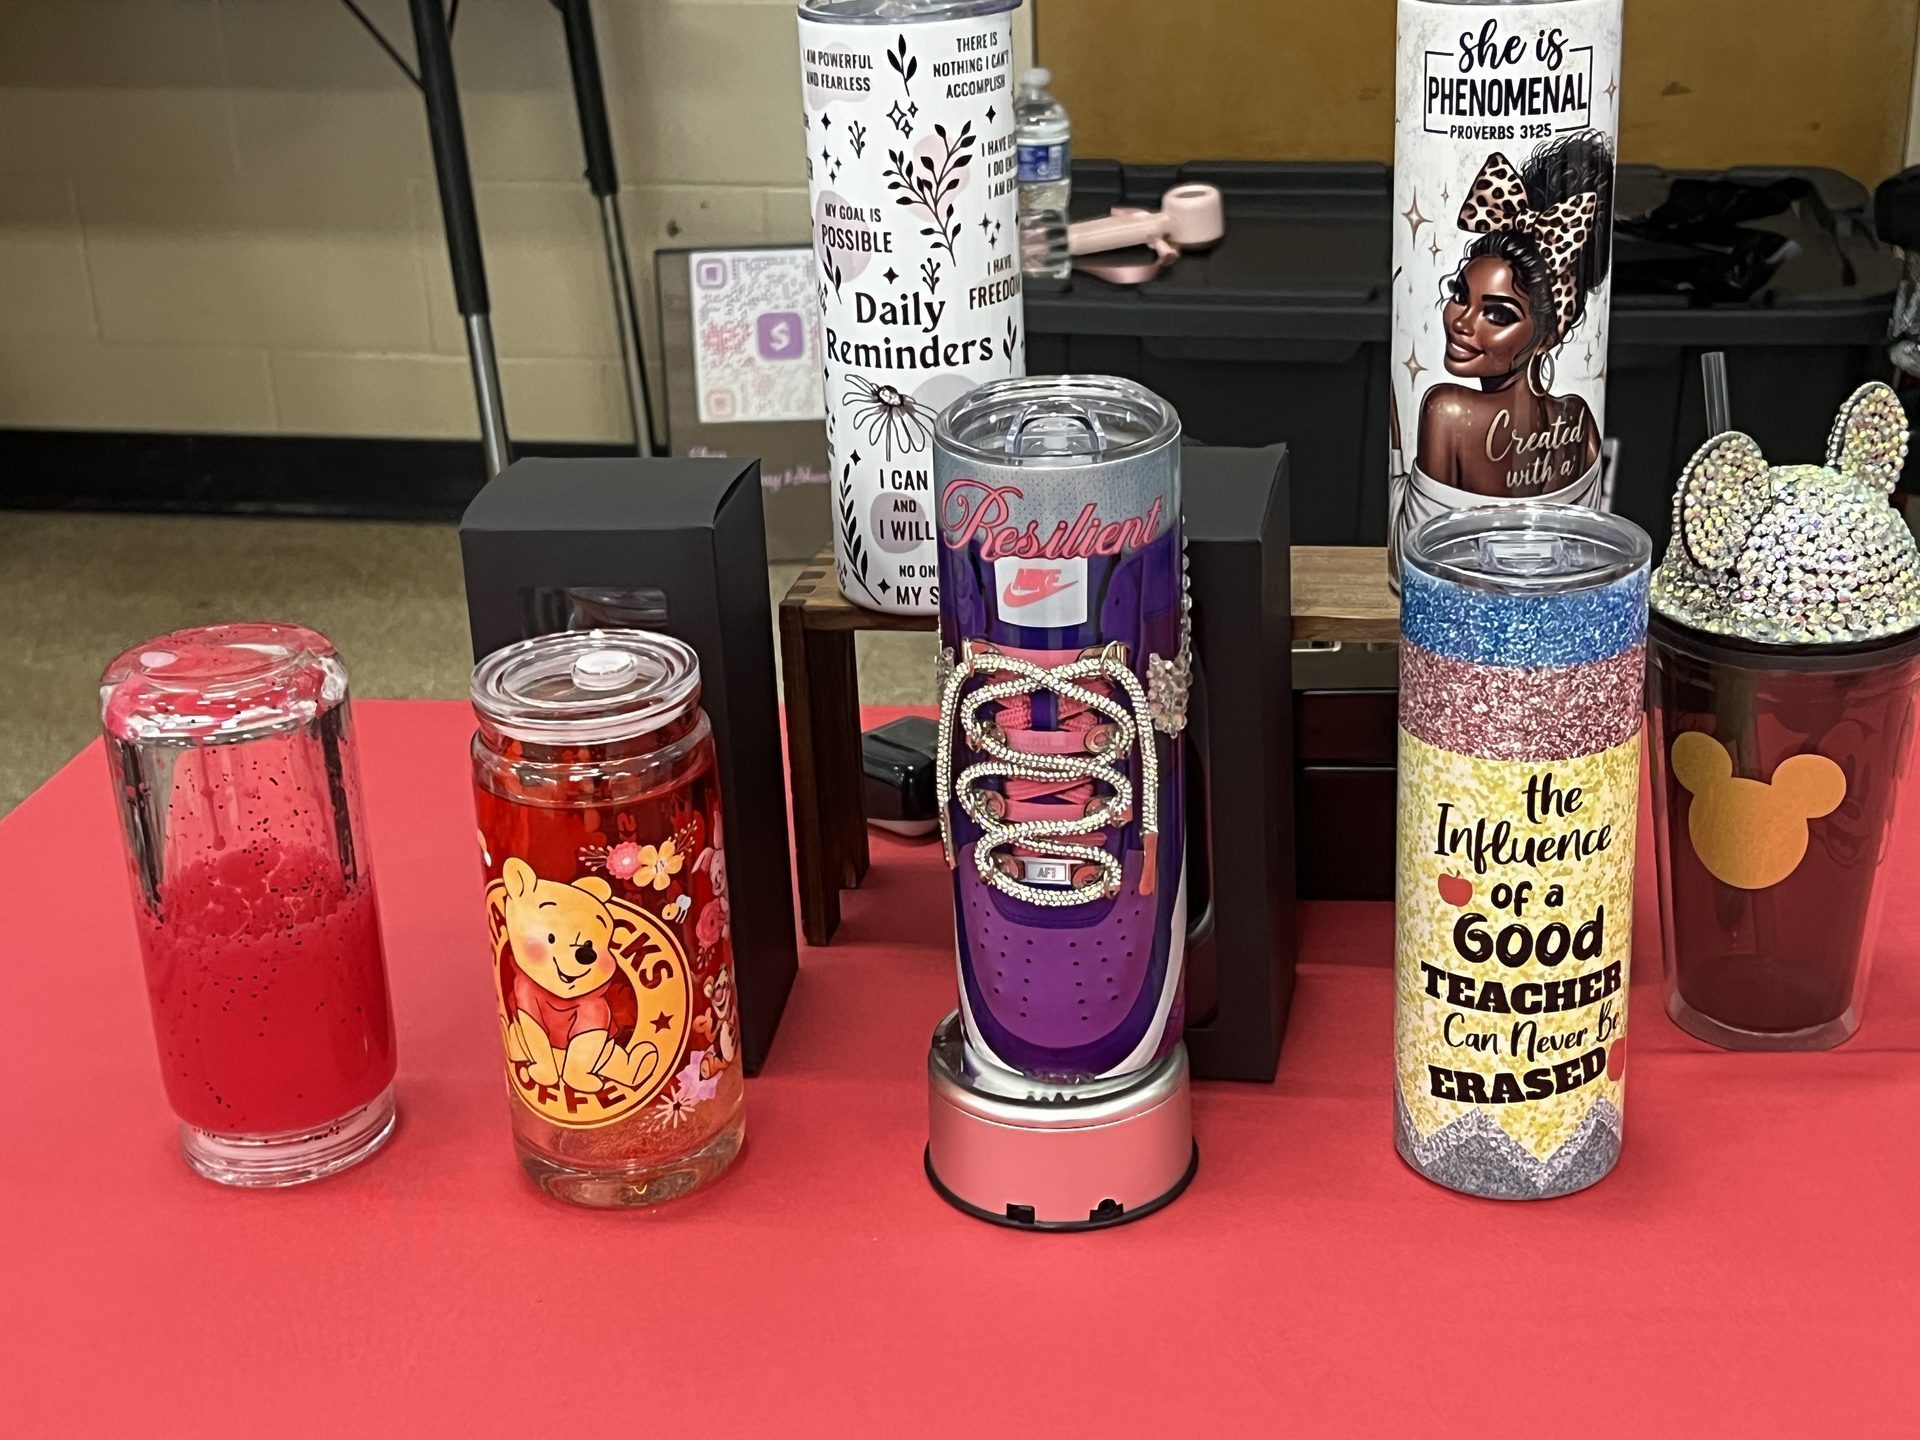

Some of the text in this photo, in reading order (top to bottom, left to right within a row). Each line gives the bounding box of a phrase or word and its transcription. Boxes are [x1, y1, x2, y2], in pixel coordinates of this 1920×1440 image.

[956, 31, 998, 53] THERE IS
[1458, 18, 1569, 73] she is
[818, 51, 873, 69] POWERFUL
[933, 57, 983, 77] NOTHING
[986, 55, 989, 70] I
[821, 73, 871, 92] FEARLESS
[946, 74, 1006, 99] ACCOMPLISH
[1428, 72, 1588, 117] PHENOMENAL
[1450, 124, 1515, 140] PROVERBS
[982, 143, 985, 157] I
[988, 136, 1006, 156] HAVE
[988, 163, 991, 178] I
[994, 160, 1004, 176] DO
[988, 184, 991, 199] I
[994, 181, 1005, 198] AM
[825, 203, 882, 222] MY GOAL IS
[822, 223, 893, 253] POSSIBLE
[987, 254, 1011, 276] I HAVE
[855, 292, 946, 332] Daily
[826, 327, 994, 369] Reminders
[1485, 406, 1586, 462] Created
[879, 469, 928, 490] I CAN
[1506, 451, 1576, 489] with a
[893, 499, 917, 513] AND
[879, 519, 935, 541] I WILL
[941, 478, 1163, 562] Resilient
[899, 565, 939, 578] NO ON
[896, 585, 922, 606] MY
[1521, 772, 1584, 824] the
[1434, 802, 1612, 875] Influence
[1490, 881, 1564, 917] of a
[1421, 960, 1622, 1015] TEACHER
[1443, 1001, 1620, 1062] Can Never Be
[1428, 1047, 1607, 1105] ERASED
